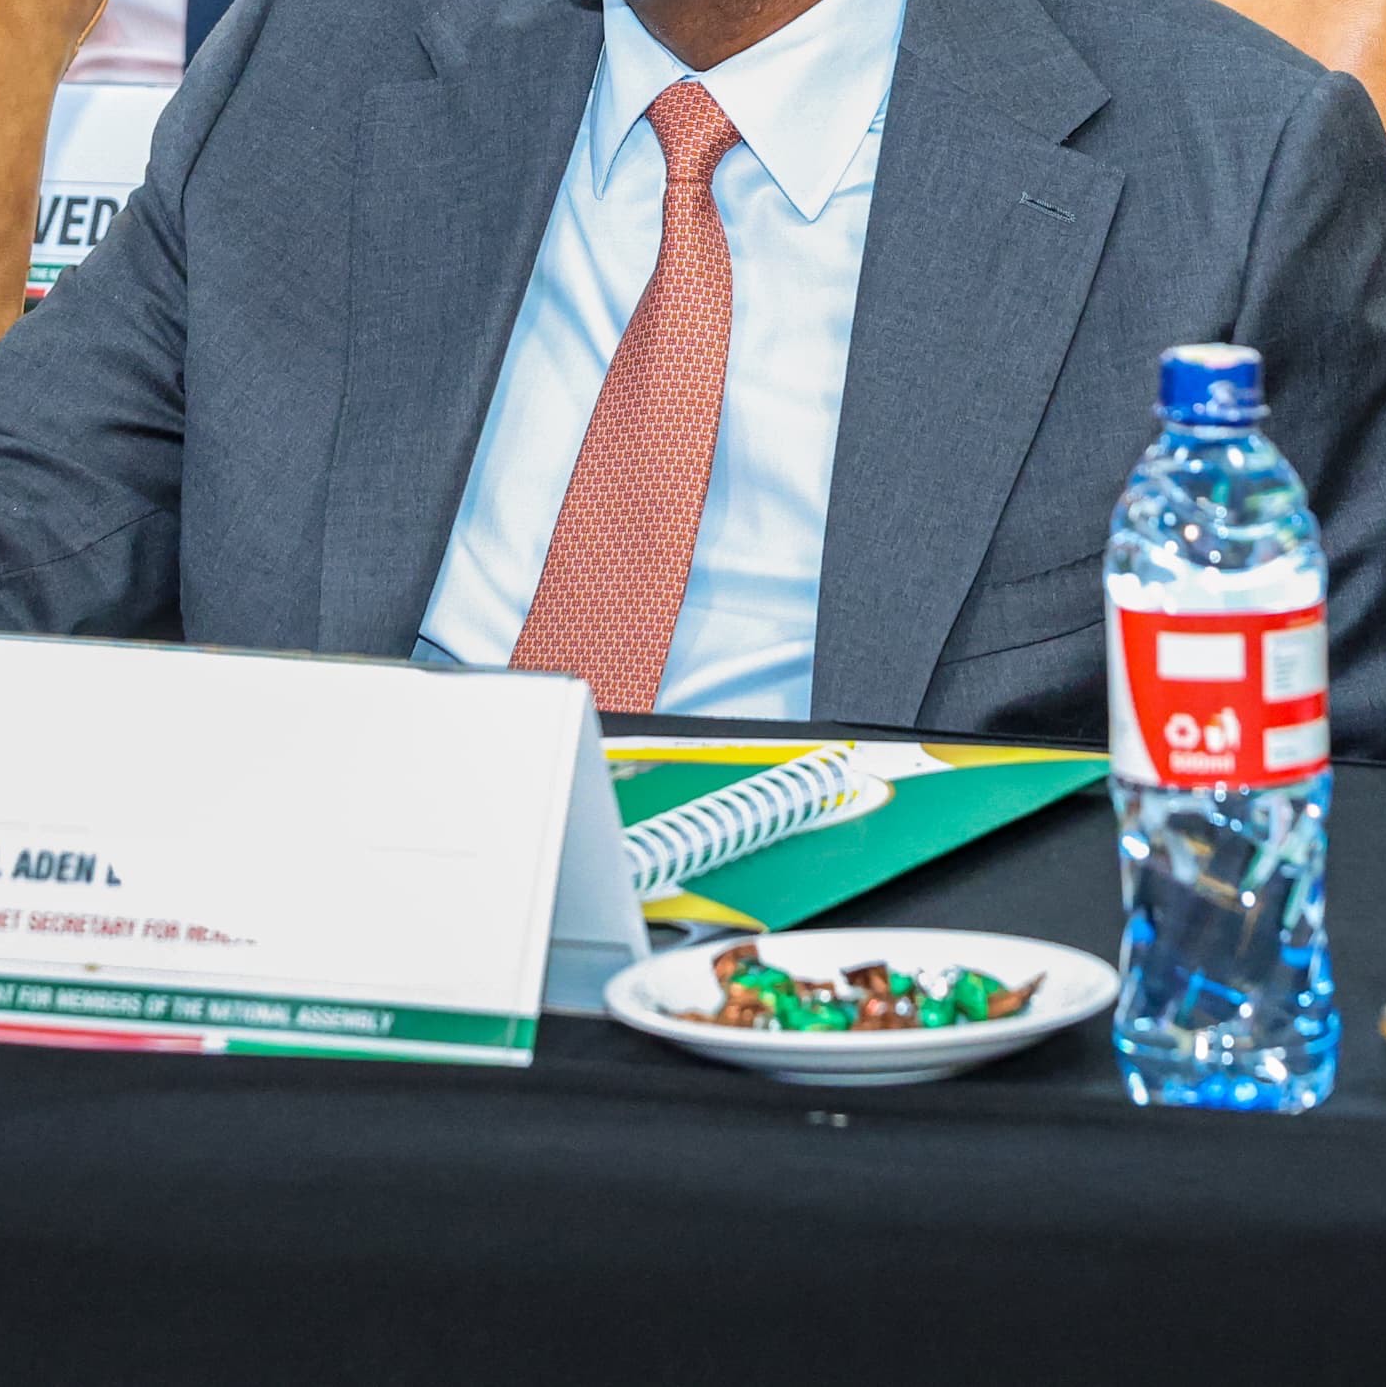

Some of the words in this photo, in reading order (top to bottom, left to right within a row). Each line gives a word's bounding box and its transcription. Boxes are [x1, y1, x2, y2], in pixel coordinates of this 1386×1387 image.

[11, 848, 97, 885] ADEN
[28, 910, 136, 938] SECRETARY
[16, 984, 54, 1010] FOR
[54, 986, 143, 1015] MEMBERS
[296, 1004, 396, 1035] ASSEMBLY
